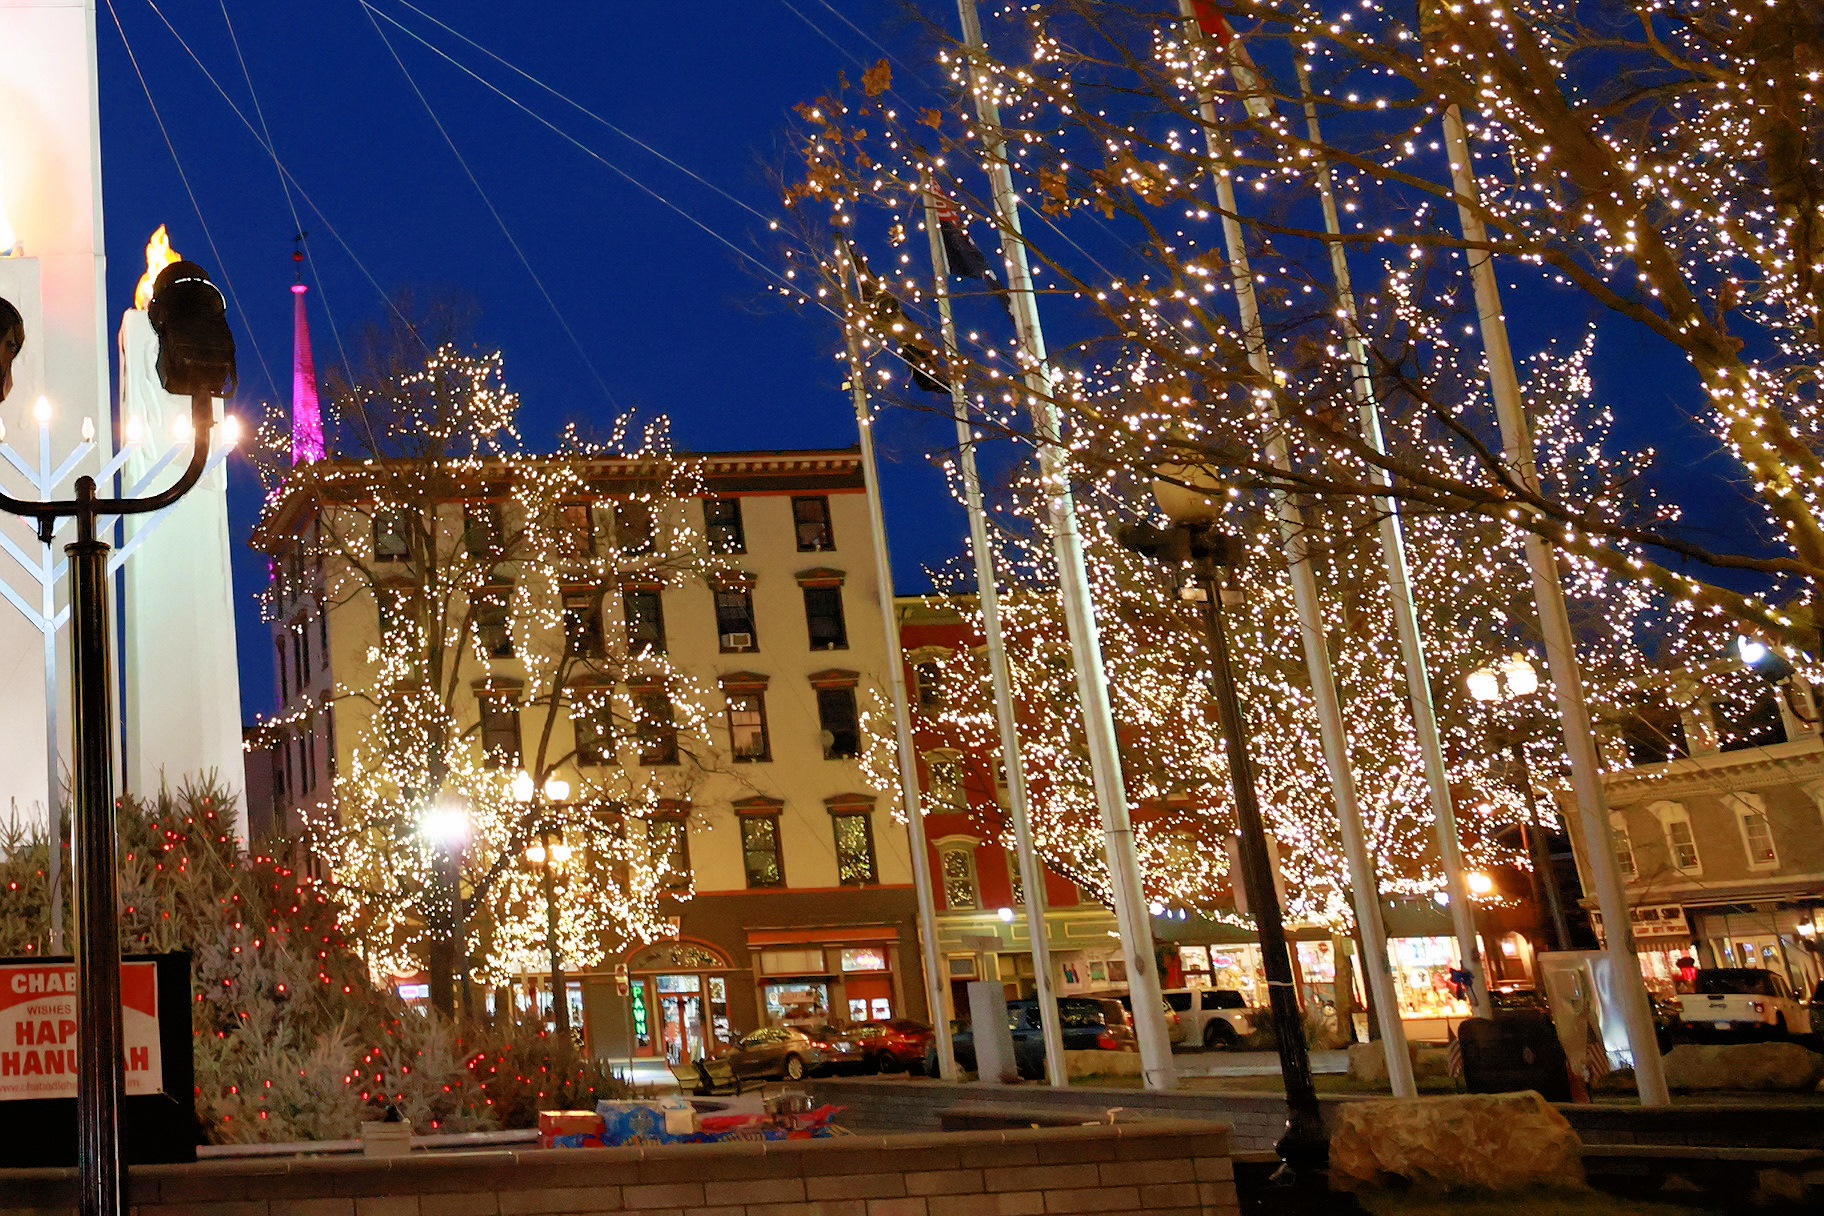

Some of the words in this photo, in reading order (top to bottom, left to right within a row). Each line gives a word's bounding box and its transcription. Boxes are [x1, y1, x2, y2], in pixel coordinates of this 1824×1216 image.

[10, 972, 77, 994] CHAB
[27, 1004, 72, 1015] WISHES
[632, 986, 647, 1035] PAWN
[15, 1020, 77, 1045] HAP
